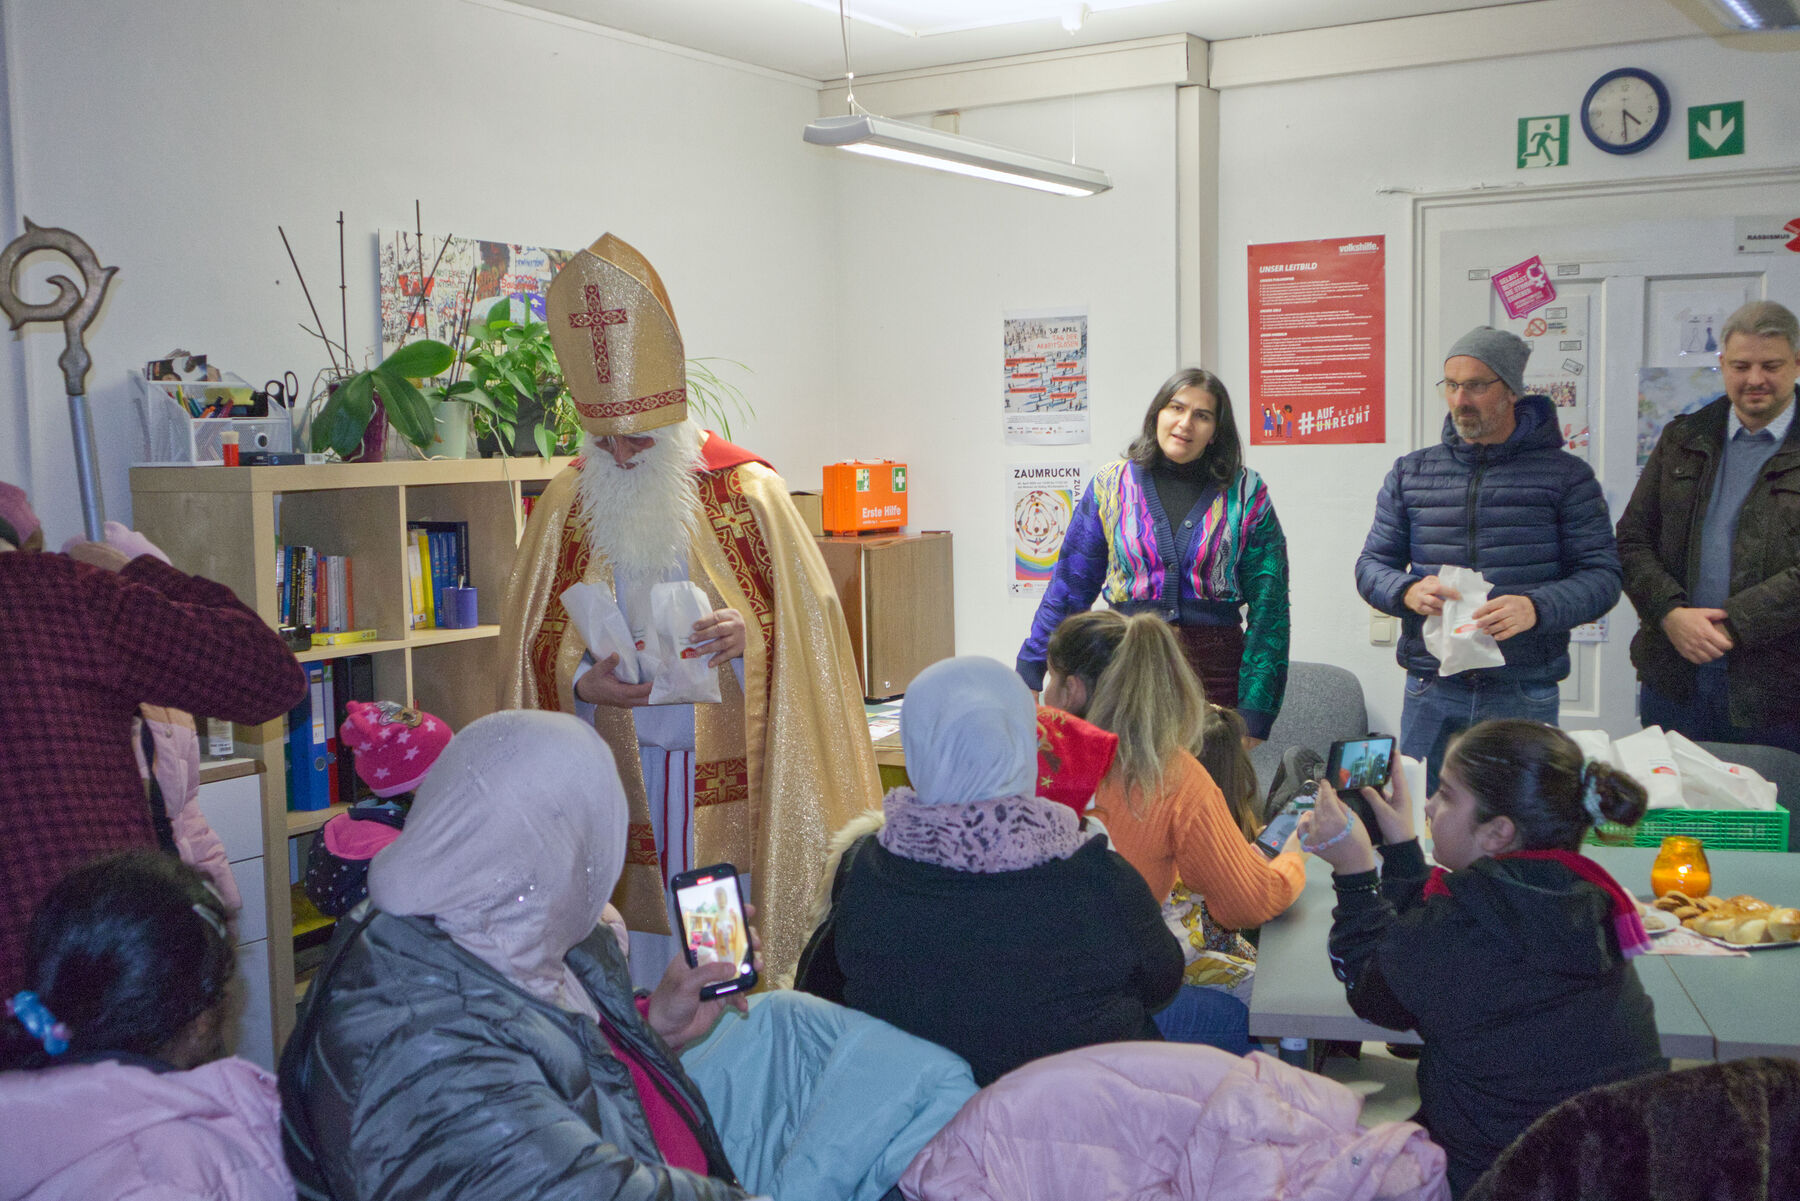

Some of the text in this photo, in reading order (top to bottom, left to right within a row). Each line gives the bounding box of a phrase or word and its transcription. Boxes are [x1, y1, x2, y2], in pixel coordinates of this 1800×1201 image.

[1259, 262, 1318, 274] UNSER LEITBILD
[1316, 410, 1370, 432] UNRECHT
[1014, 467, 1080, 479] ZAUMRUCKN
[862, 504, 901, 519] Erste Hilfe
